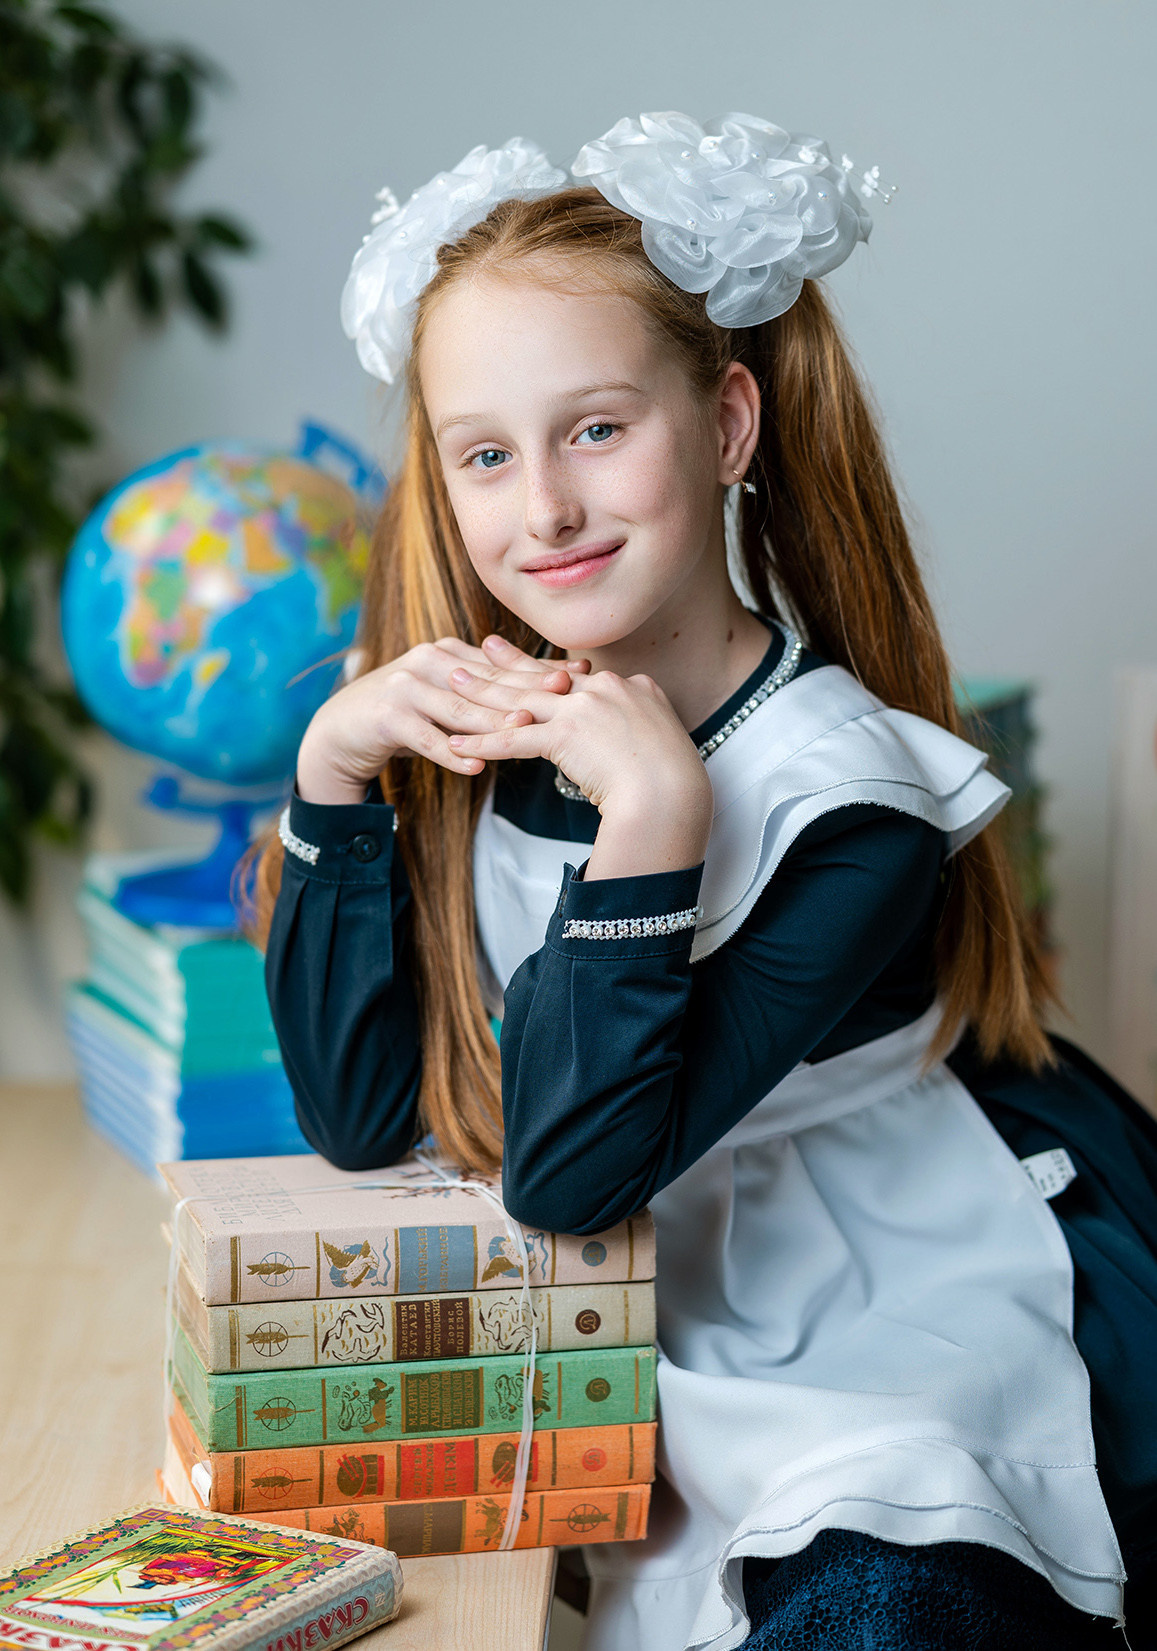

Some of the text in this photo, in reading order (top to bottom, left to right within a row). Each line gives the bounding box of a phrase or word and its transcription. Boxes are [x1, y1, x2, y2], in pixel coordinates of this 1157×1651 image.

[417, 1228, 428, 1292] М.ГОРЬКИЙ
[440, 1226, 449, 1291] ИЗБРАННОЕ
[399, 1304, 408, 1356] Валентин
[408, 1303, 418, 1355] КАТАЕВ
[423, 1302, 432, 1357] Константин
[431, 1299, 441, 1357] ПАУСТОВСКИЙ
[447, 1310, 455, 1345] Борис
[455, 1301, 464, 1353] ПОЛЕВОЙ
[414, 1447, 422, 1494] СЕРГЕЙ
[425, 1443, 434, 1496] МИХАЛКОВ
[444, 1442, 457, 1493] ДЕТЯМ
